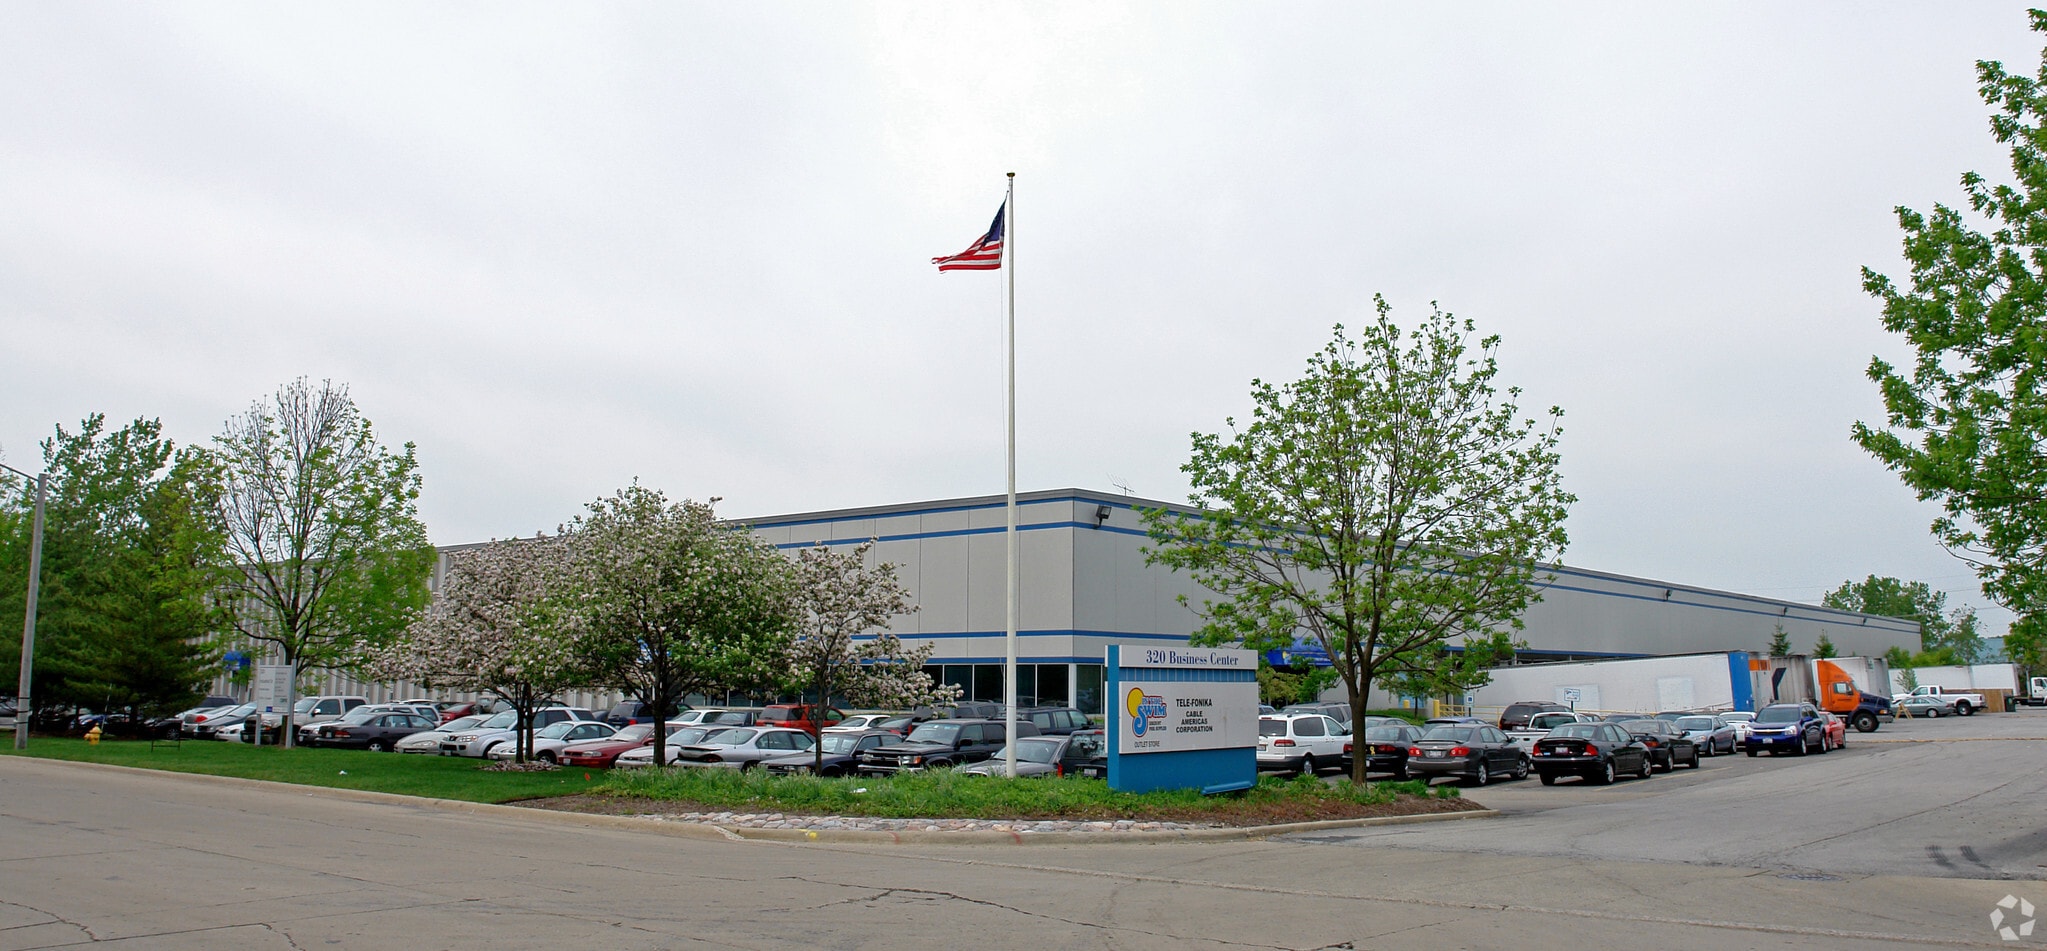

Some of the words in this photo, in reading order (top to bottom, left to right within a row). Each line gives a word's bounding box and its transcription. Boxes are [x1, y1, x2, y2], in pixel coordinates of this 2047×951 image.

[1146, 650, 1166, 664] 320
[1169, 650, 1208, 665] Business
[1210, 651, 1239, 666] Center
[1175, 698, 1213, 707] TELE-FONIKA
[1134, 705, 1166, 735] SWIM
[1175, 725, 1213, 733] CORPORATION
